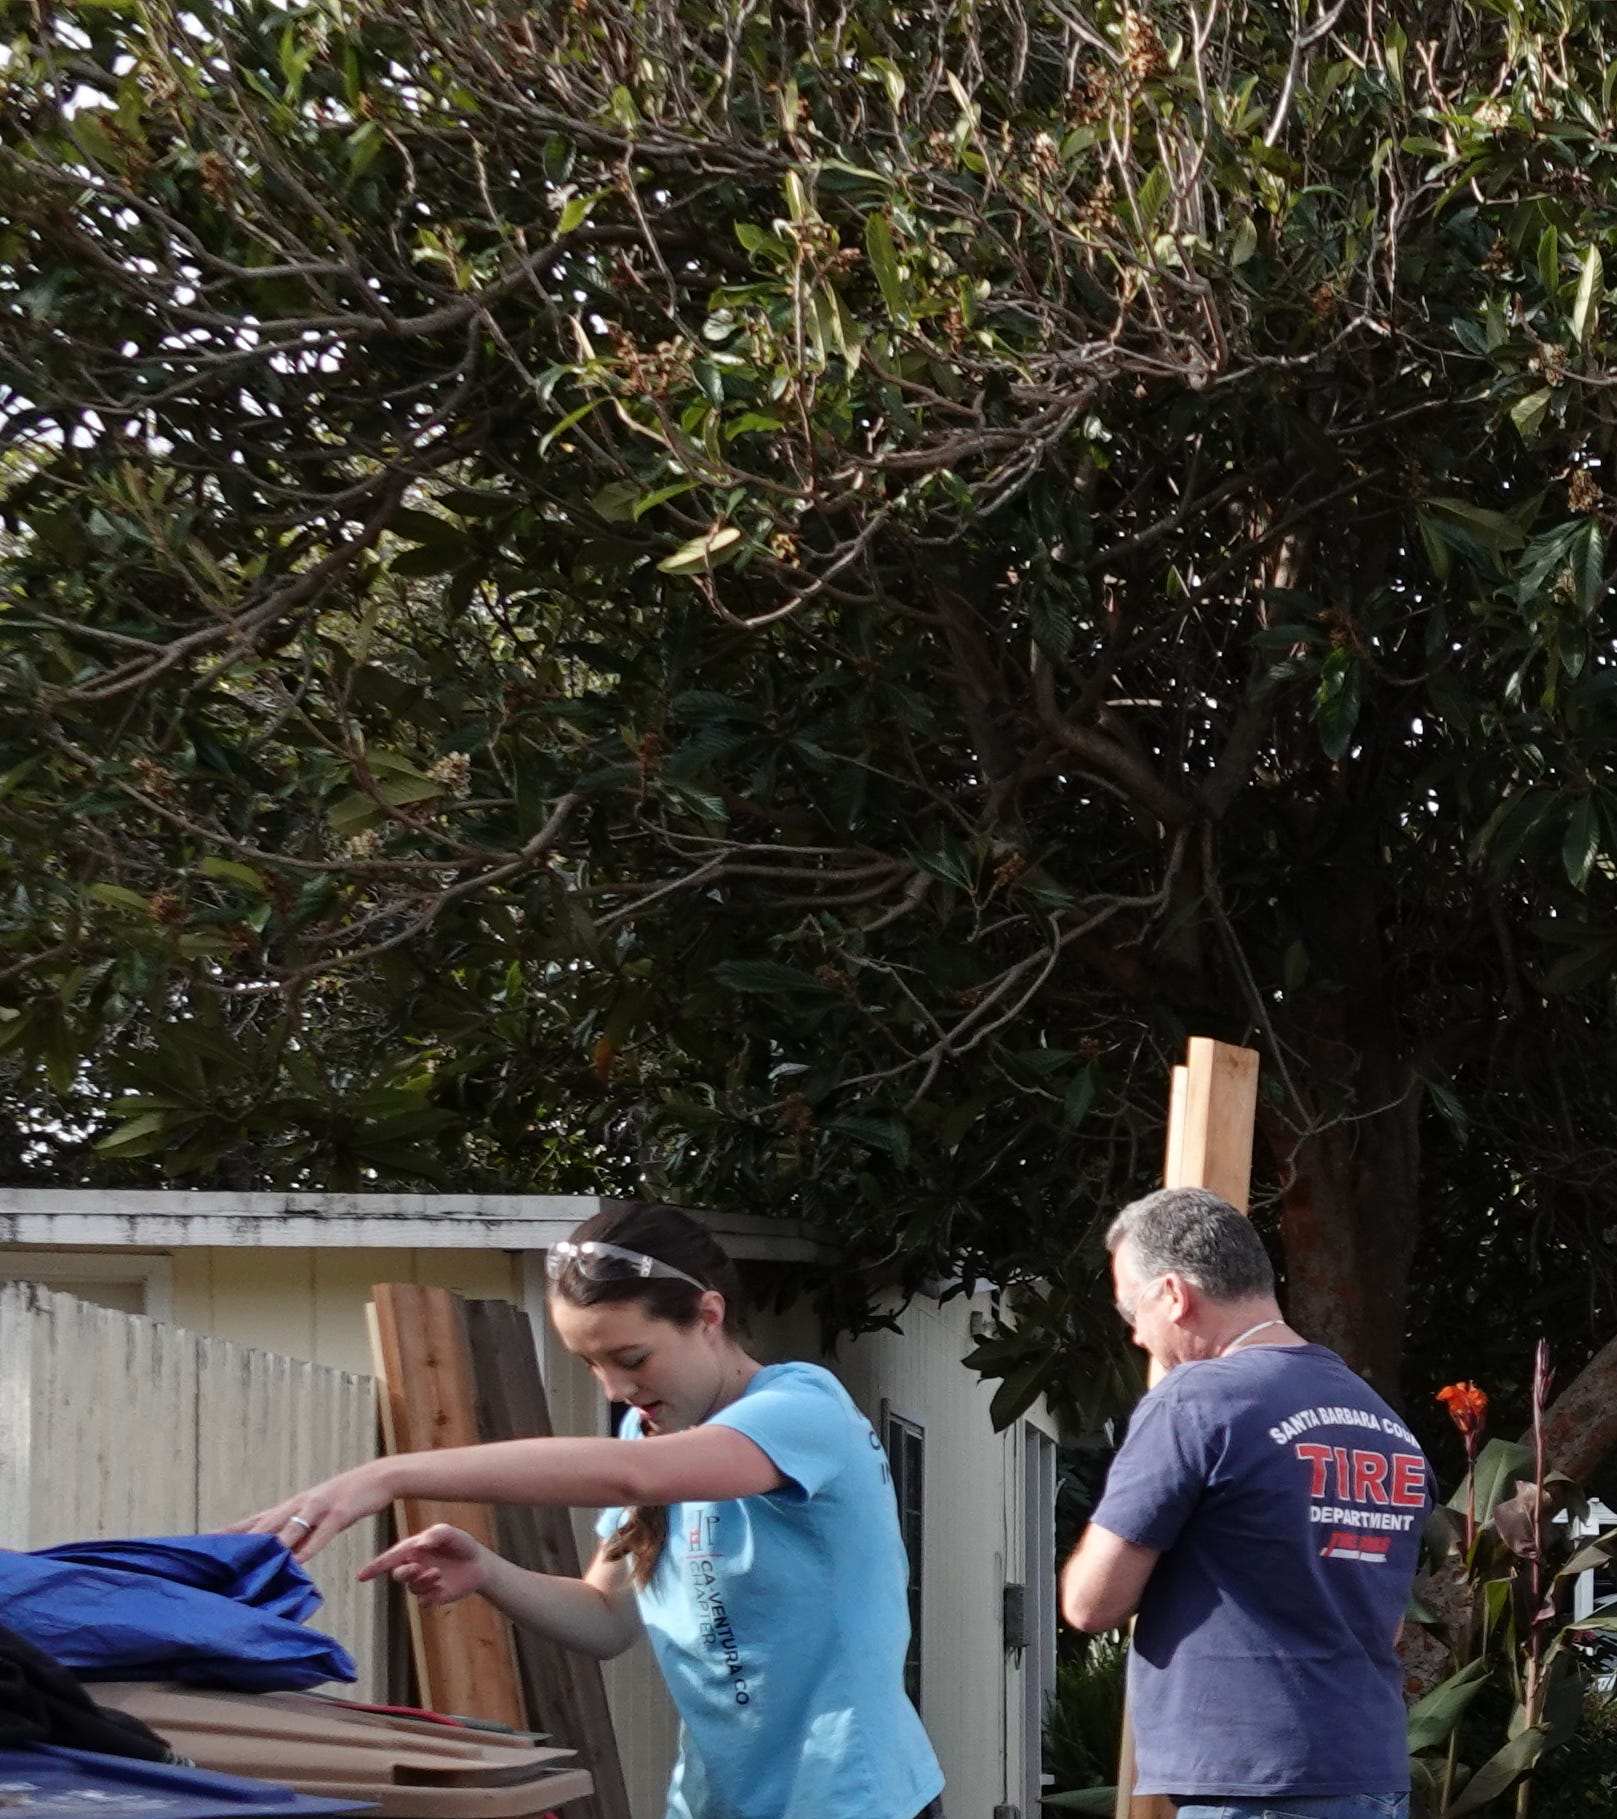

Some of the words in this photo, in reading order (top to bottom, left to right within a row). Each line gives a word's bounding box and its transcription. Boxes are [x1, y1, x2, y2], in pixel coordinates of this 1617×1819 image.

[1269, 1409, 1321, 1445] SANTA
[1317, 1406, 1381, 1431] BARBARA
[1309, 1505, 1415, 1531] DEPARTMENT
[689, 1560, 717, 1647] CHAPTER
